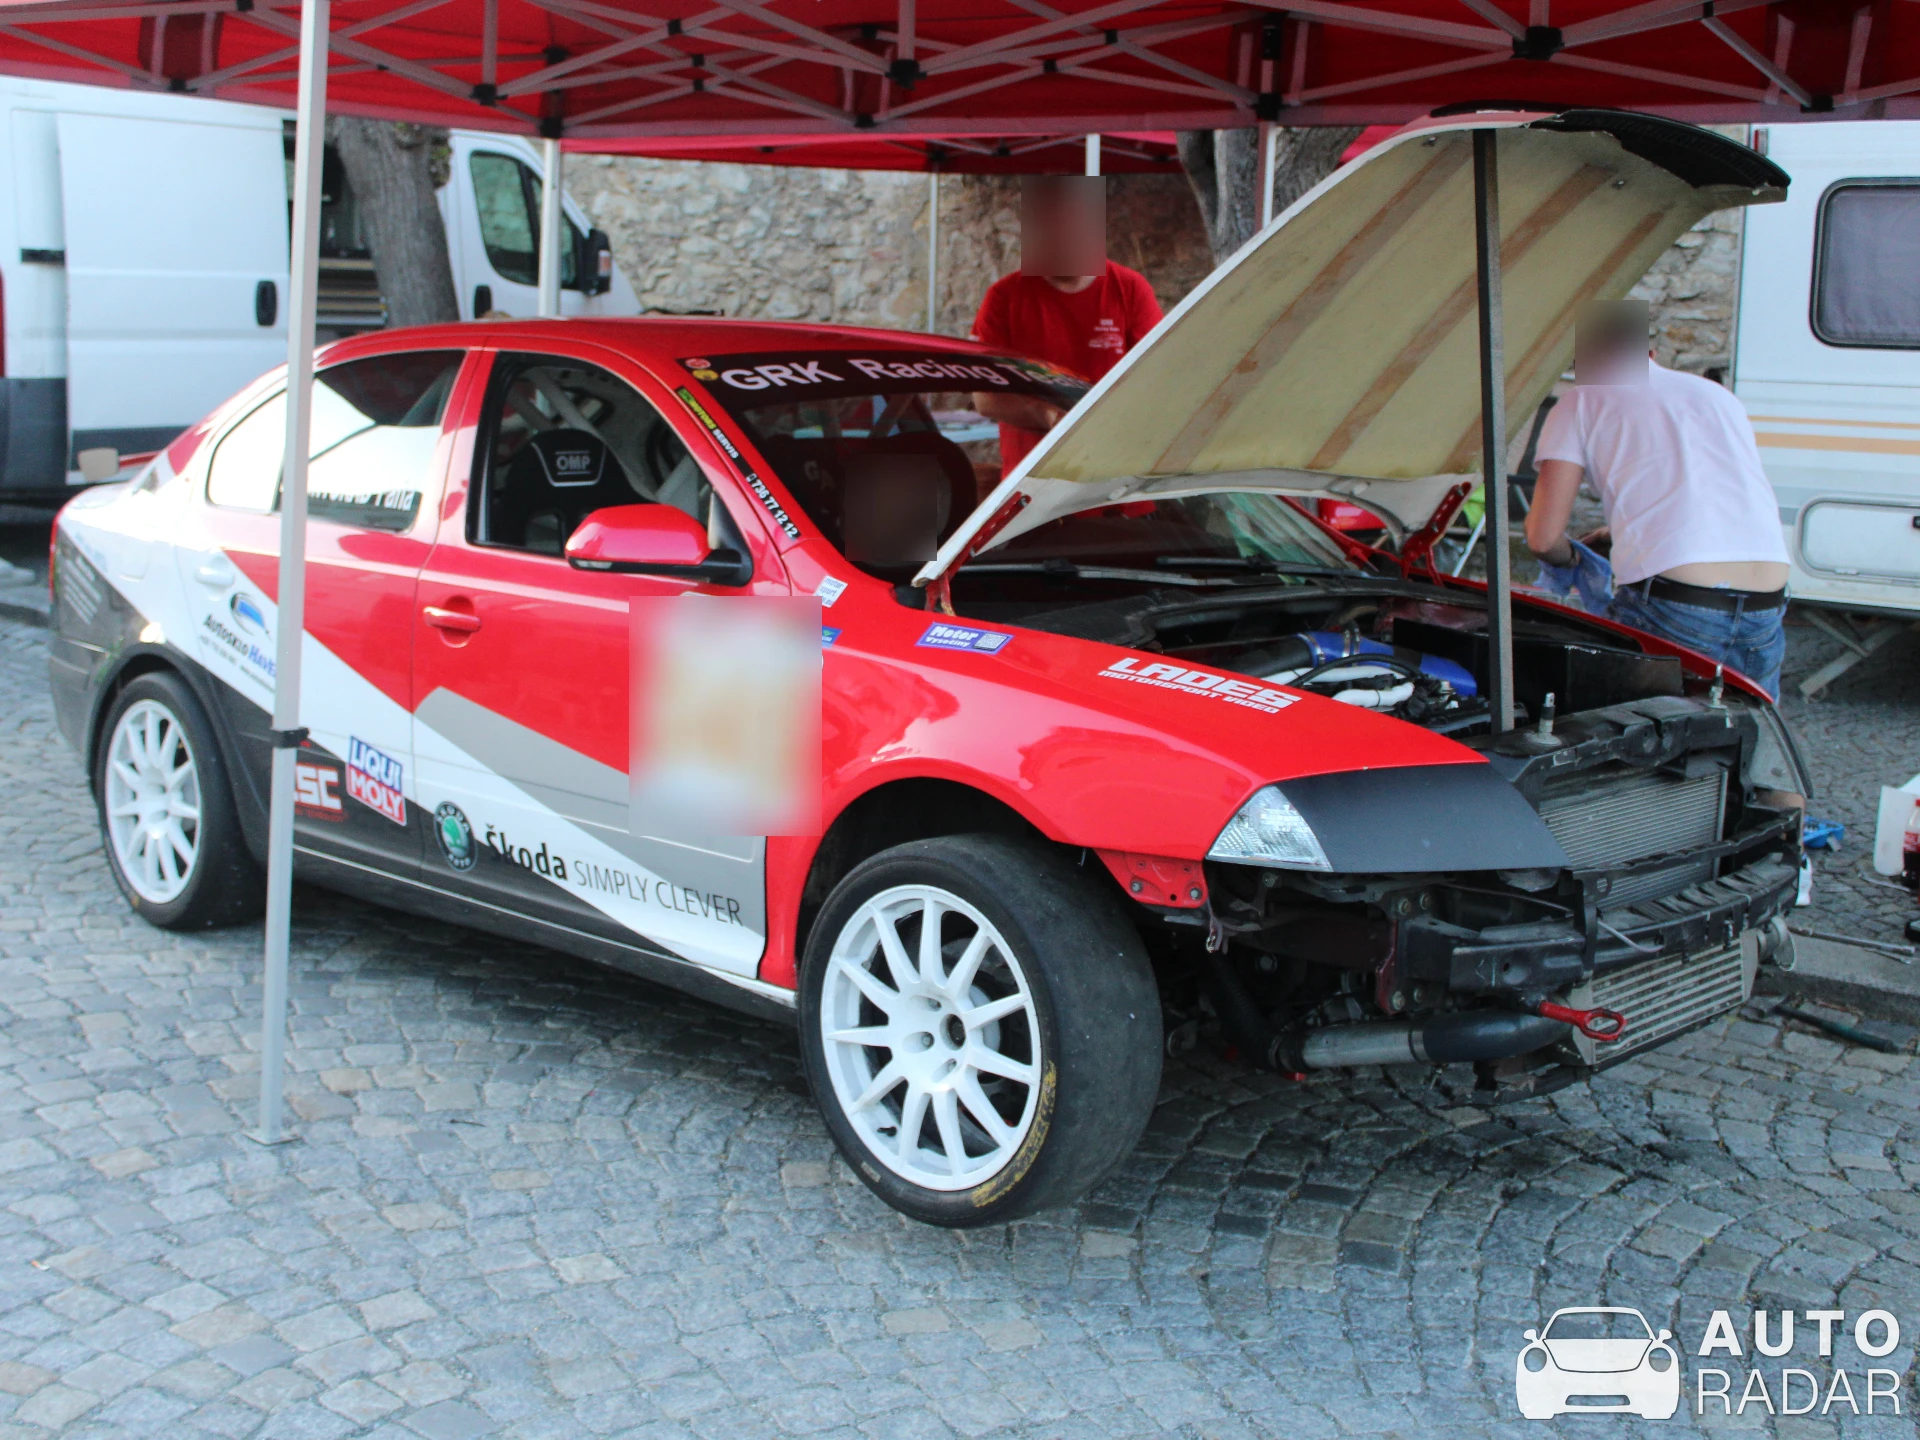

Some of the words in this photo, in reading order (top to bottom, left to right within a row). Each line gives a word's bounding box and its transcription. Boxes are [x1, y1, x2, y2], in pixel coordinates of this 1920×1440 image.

[720, 360, 845, 390] GRK
[847, 358, 1010, 386] Racing
[556, 455, 591, 471] OMP
[713, 428, 739, 459] SERVIS
[751, 479, 770, 499] 736
[764, 497, 780, 511] 77
[774, 510, 789, 525] 12
[784, 522, 799, 538] 12
[929, 625, 979, 641] Motor
[1097, 670, 1224, 699] MOTORSPORT
[1222, 694, 1281, 714] VIDEO
[1107, 657, 1303, 709] LADES
[293, 764, 343, 810] SC
[350, 739, 402, 792] LIQUI
[350, 768, 402, 819] MOLY
[573, 860, 648, 903] SIMPLY
[655, 881, 744, 927] CLEVER
